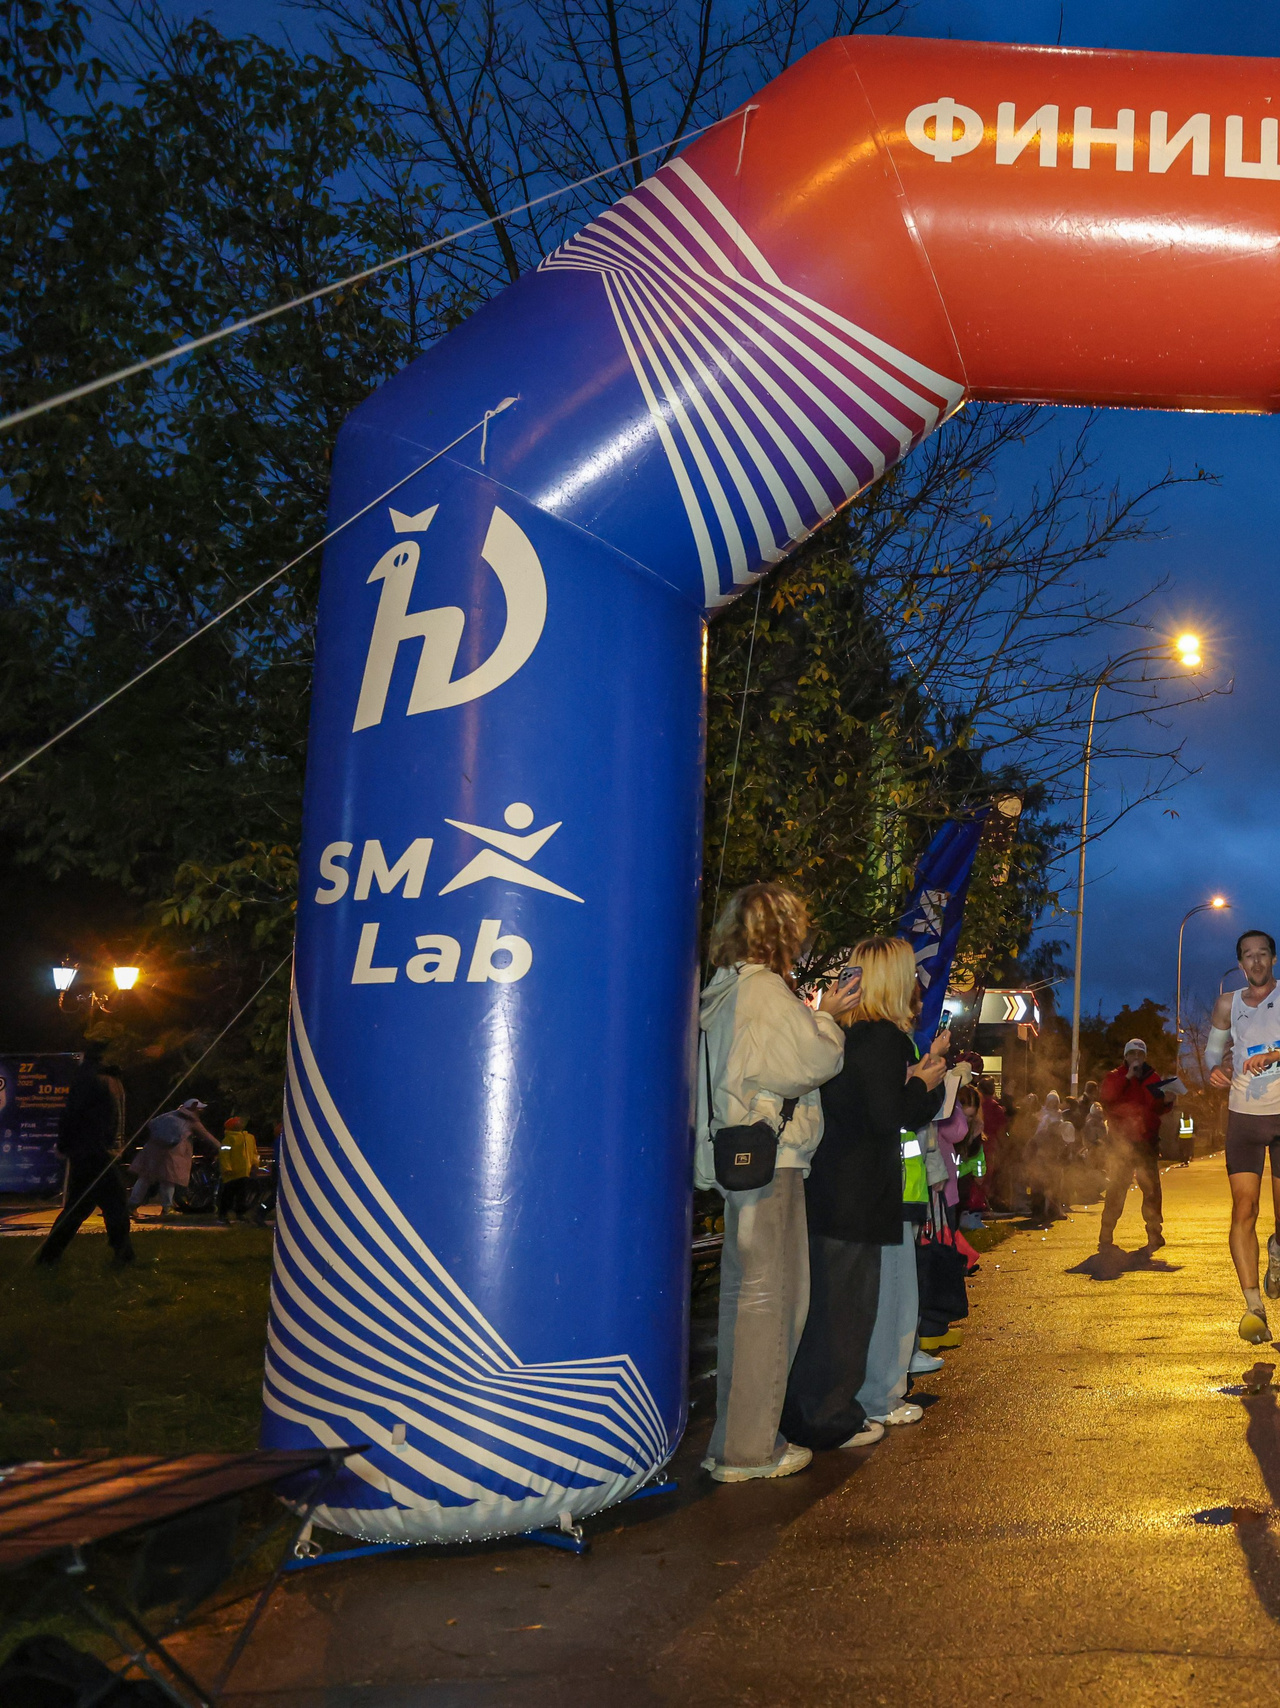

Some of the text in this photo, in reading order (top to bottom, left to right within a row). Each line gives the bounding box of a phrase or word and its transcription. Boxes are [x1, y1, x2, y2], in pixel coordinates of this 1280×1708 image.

[315, 838, 434, 905] SM
[351, 919, 532, 985] Lab
[18, 1063, 34, 1073] 27
[38, 1084, 53, 1094] 10
